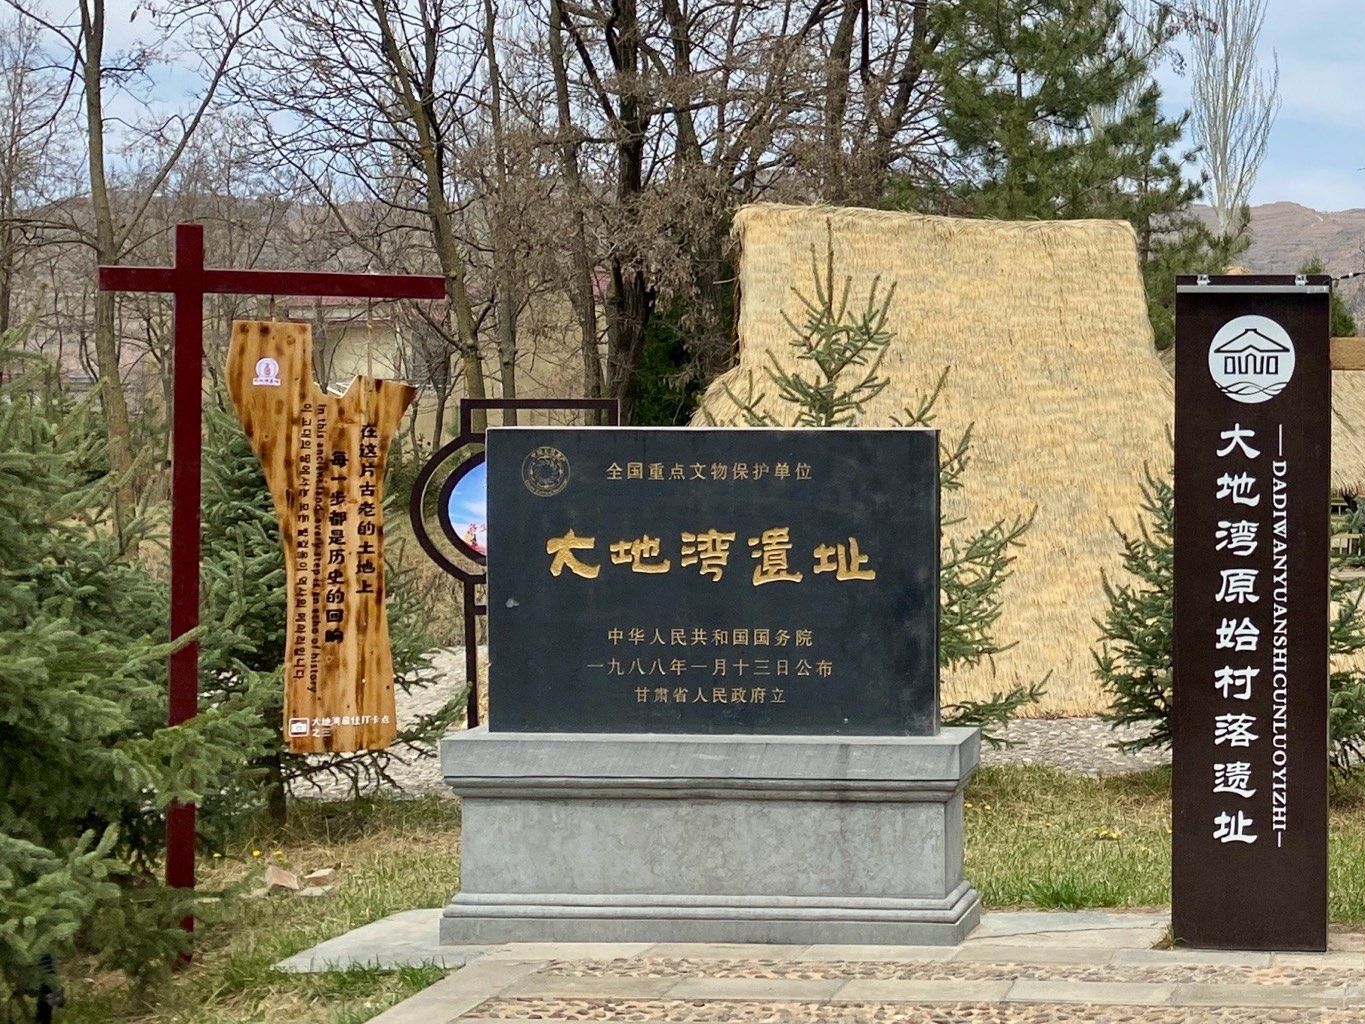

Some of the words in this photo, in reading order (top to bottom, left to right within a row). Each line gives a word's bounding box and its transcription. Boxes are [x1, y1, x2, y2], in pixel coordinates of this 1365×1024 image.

[301, 403, 313, 413] 이
[317, 403, 327, 415] In
[300, 417, 312, 450] 고대의
[317, 418, 327, 439] this
[316, 442, 327, 483] ancient
[605, 462, 813, 481] 全国重点文物保护单位
[298, 454, 311, 498] 땅에서는
[356, 424, 378, 594] 在这片古老的土地上
[311, 518, 324, 549] every
[311, 551, 323, 576] step
[312, 578, 323, 589] is
[312, 591, 322, 605] an
[311, 608, 321, 634] echo
[311, 637, 321, 650] of
[607, 628, 814, 647] 中华人民共和国国务院
[1211, 423, 1261, 846] 大地湾原始村落遗址
[307, 652, 321, 693] history
[587, 659, 833, 677] 一九八八年一月十三日公布
[634, 686, 786, 704] 甘肃省人民政府立
[312, 728, 332, 738] 之三
